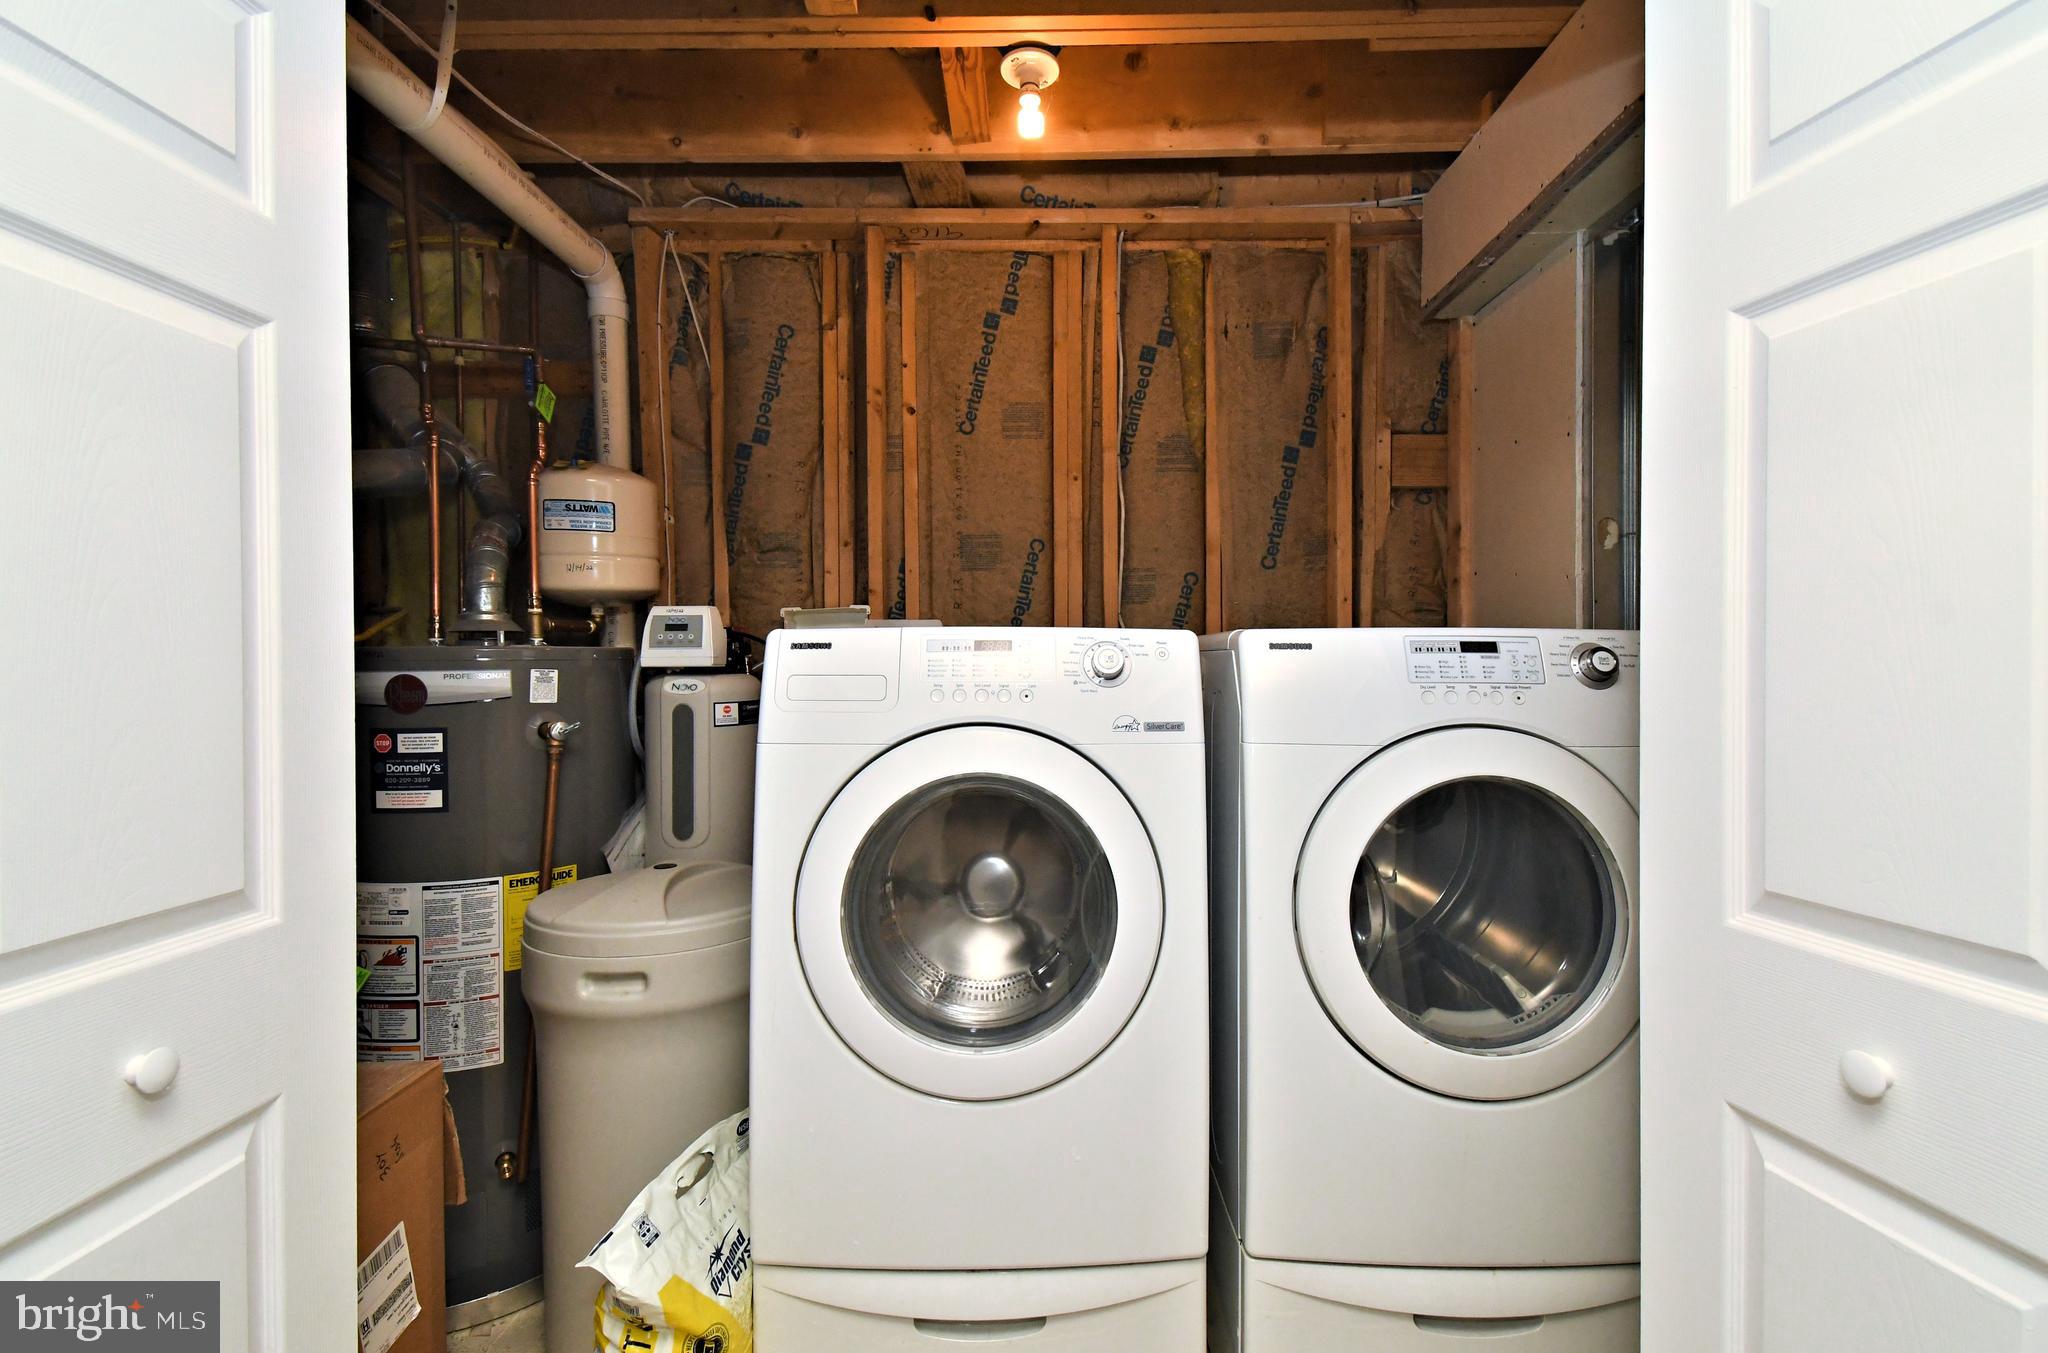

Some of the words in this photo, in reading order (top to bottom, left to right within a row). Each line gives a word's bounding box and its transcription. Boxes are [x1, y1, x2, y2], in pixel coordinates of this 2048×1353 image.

[756, 324, 795, 427] CertainTeed
[958, 331, 998, 436] CertainTeed
[565, 503, 598, 513] WATTS
[1260, 465, 1297, 570] CertainTeed
[790, 642, 832, 650] SAMSUNG
[1269, 642, 1313, 650] SAMSUNG
[386, 763, 441, 774] Donnelly's
[710, 1228, 746, 1295] Diamond
